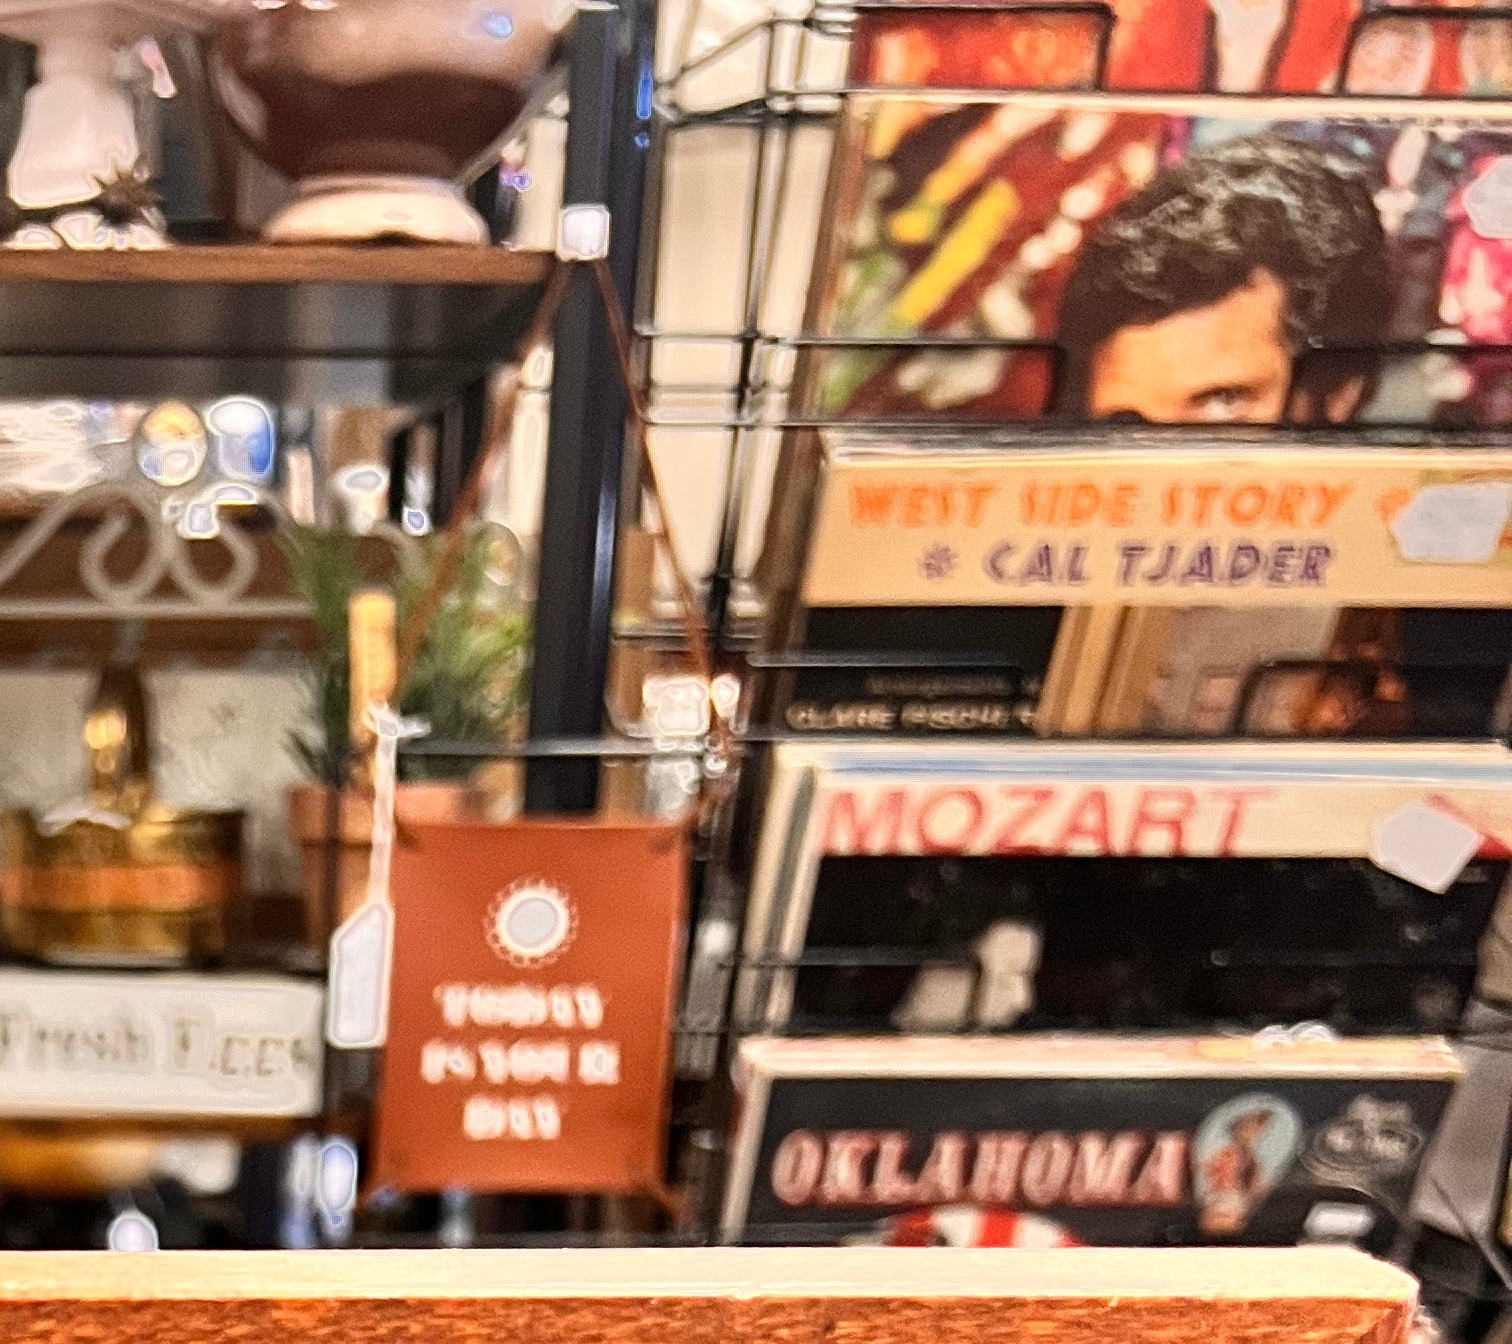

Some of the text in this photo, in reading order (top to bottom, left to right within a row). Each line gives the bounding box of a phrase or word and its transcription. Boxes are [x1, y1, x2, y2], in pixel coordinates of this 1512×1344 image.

[849, 484, 999, 528] WEST
[1019, 484, 1138, 528] SIDE
[1161, 483, 1354, 528] STORY
[984, 539, 1333, 586] CAL TJADER
[819, 784, 1273, 858] MOZART
[771, 1128, 1194, 1207] OKLAHOMA
